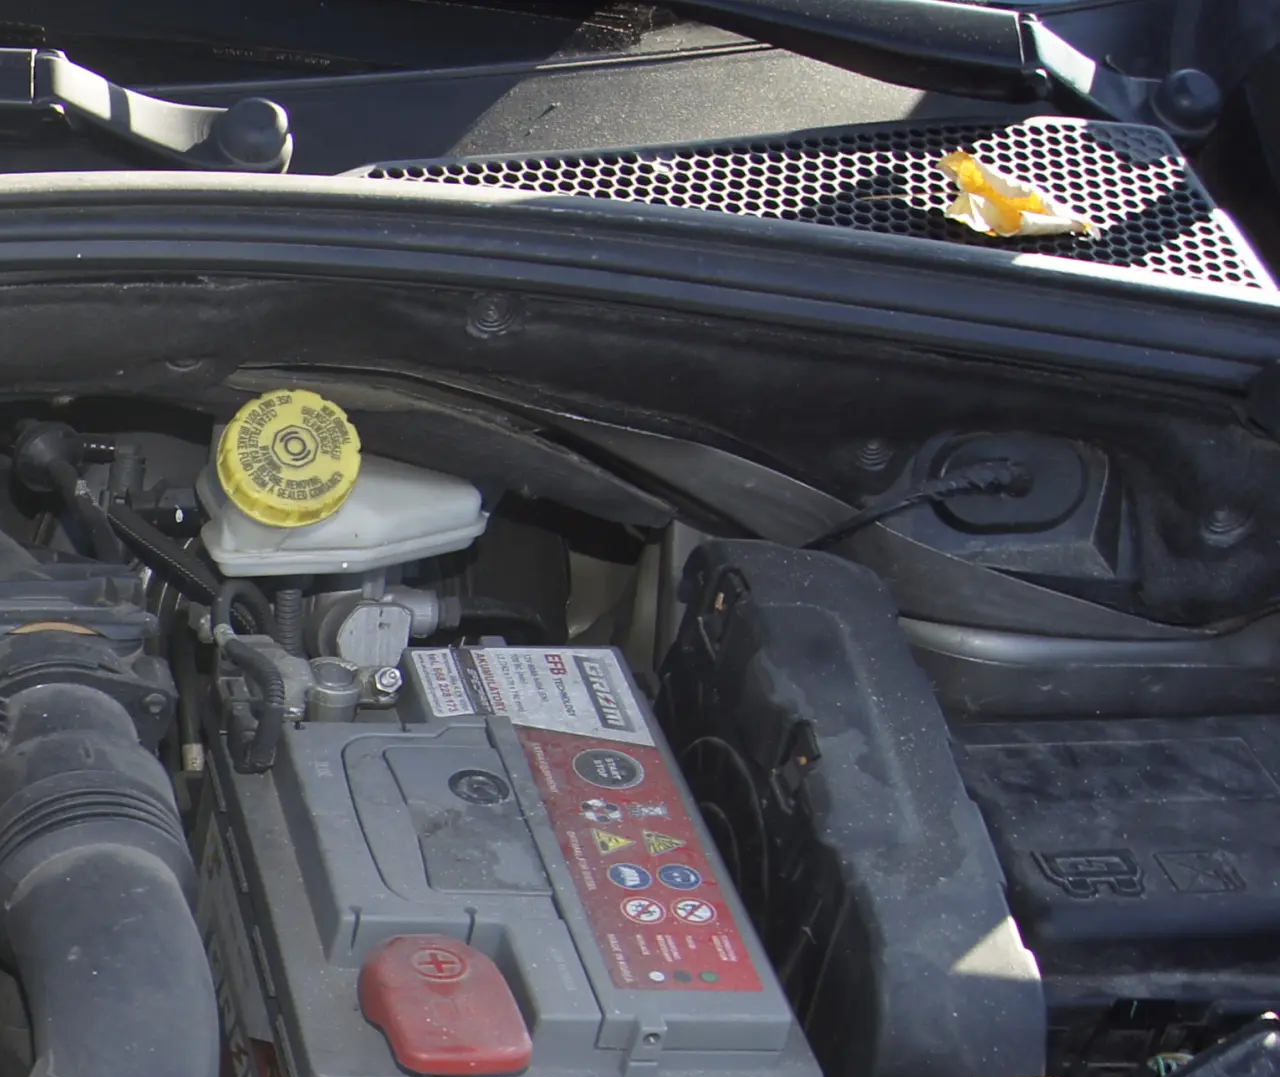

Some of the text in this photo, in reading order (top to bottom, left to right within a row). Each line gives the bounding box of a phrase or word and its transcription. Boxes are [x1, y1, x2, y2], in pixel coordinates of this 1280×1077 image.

[544, 653, 569, 676] EFB
[474, 653, 507, 712] AKUMULATORY
[593, 759, 608, 778] STOP
[604, 757, 622, 780] START
